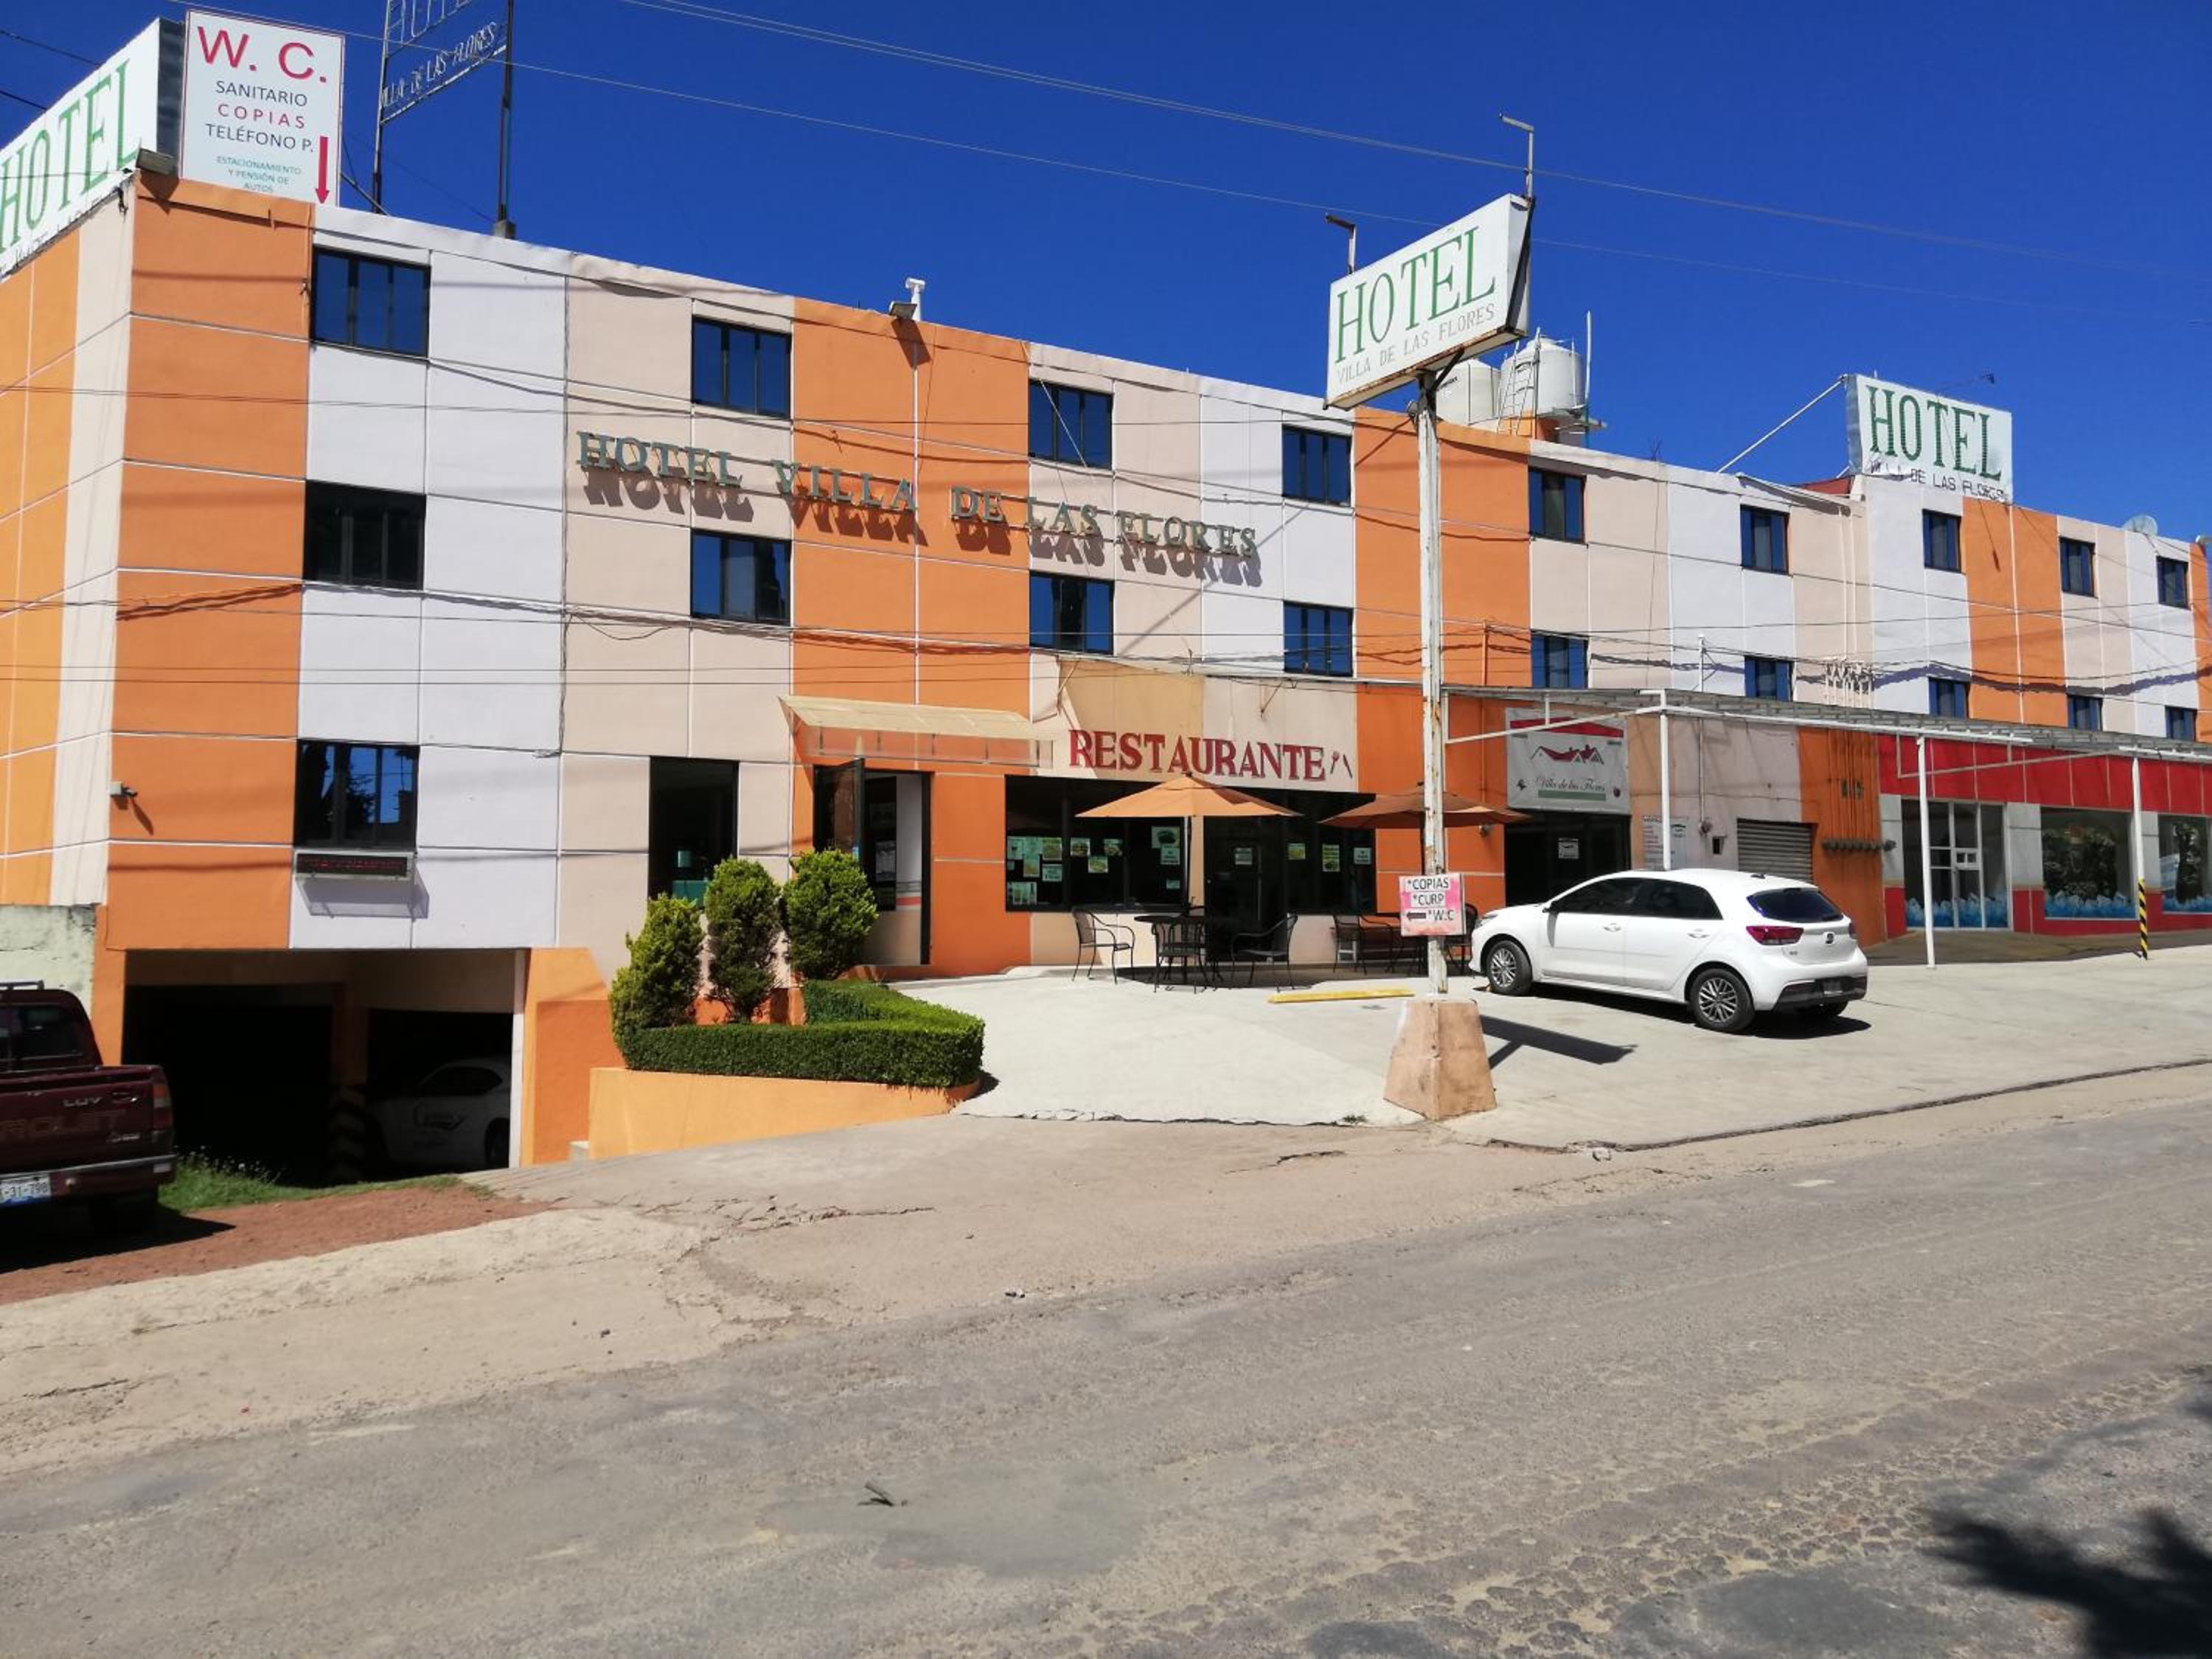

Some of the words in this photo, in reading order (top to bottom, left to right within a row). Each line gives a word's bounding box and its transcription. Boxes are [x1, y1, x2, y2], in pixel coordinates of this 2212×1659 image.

[197, 26, 257, 72] W.
[278, 42, 327, 83] C.
[215, 80, 307, 107] SANITARIO
[218, 104, 305, 129] COPIAS
[0, 58, 142, 253] HOTEL
[206, 123, 296, 150] TELÉFONO
[302, 139, 313, 153] P.
[217, 156, 302, 175] ESTACIONAMIENTO
[228, 168, 234, 176] Y
[236, 170, 276, 183] PENSIÓN
[277, 175, 289, 185] DE
[243, 182, 274, 193] AUTOS
[1335, 226, 1495, 363] HOTEL
[1338, 358, 1371, 384] VILLA
[1380, 345, 1395, 366] DE
[1404, 331, 1429, 355] LAS
[1439, 303, 1495, 341] FLORES
[1866, 385, 2001, 481] HOTEL
[576, 431, 742, 487] HOTEL
[771, 459, 917, 512] VILLA
[950, 487, 1004, 521] DE
[1027, 496, 1099, 535] LAS
[1116, 510, 1256, 554] FLORES
[1910, 468, 1926, 484] DE
[1933, 473, 1956, 492] LAS
[1068, 729, 1326, 782] RESTAURANTE
